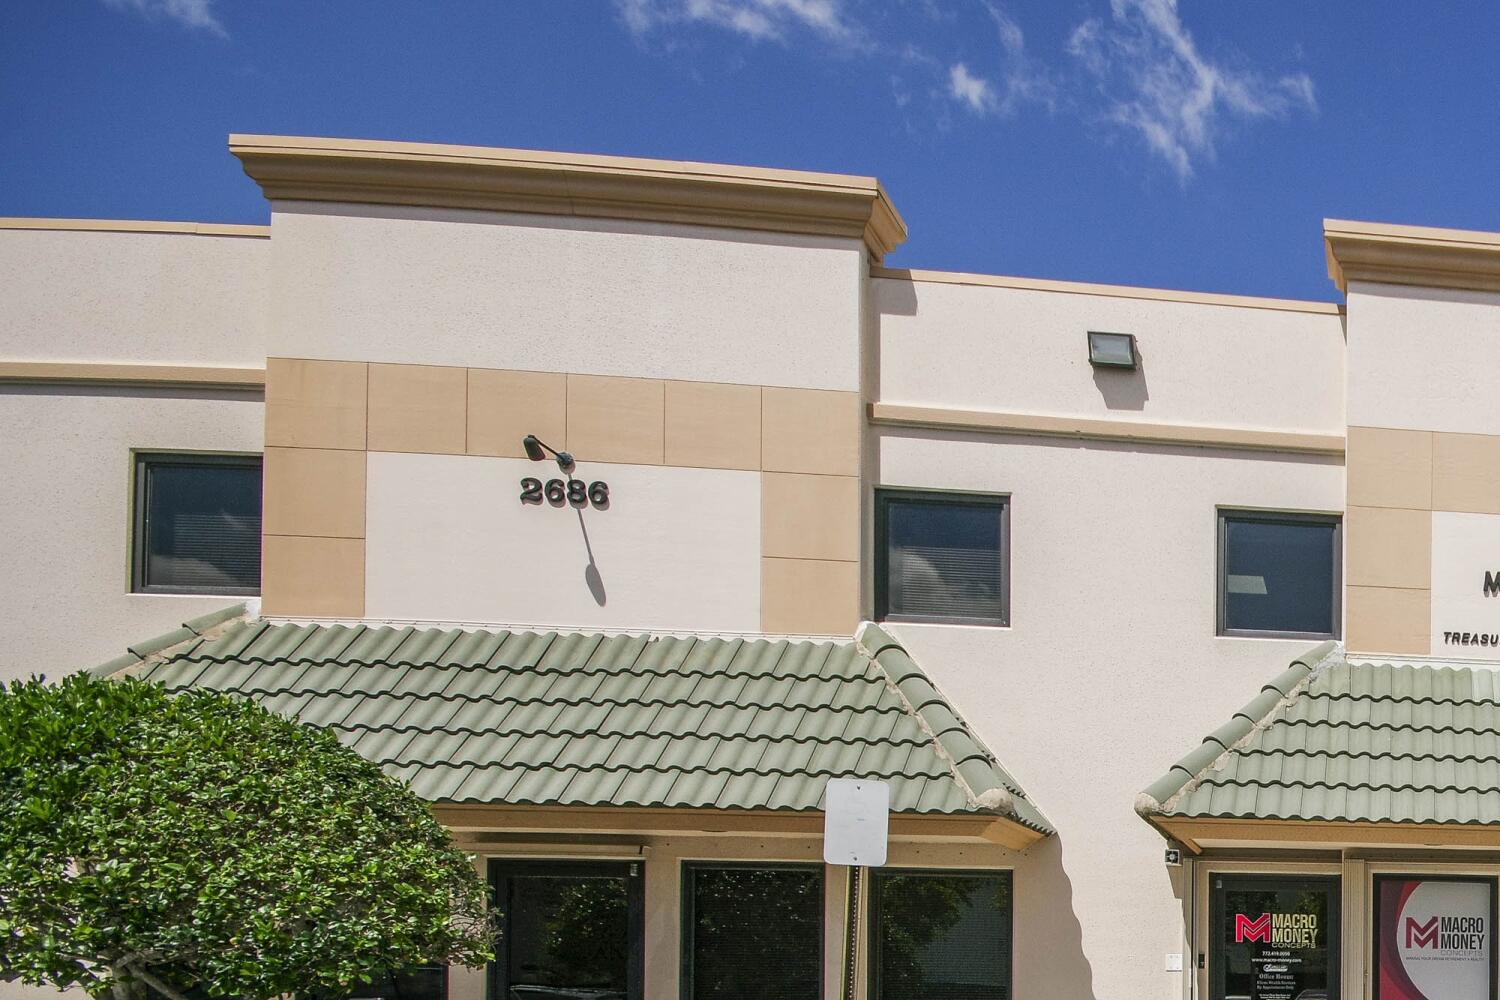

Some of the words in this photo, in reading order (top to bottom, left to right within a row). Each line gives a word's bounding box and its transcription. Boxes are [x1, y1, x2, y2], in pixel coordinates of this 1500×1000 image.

[520, 477, 609, 505] 2686
[1272, 913, 1317, 928] MACRO
[1441, 916, 1484, 933] MACRO
[1272, 929, 1319, 943] MONEY
[1440, 934, 1485, 949] MONEY
